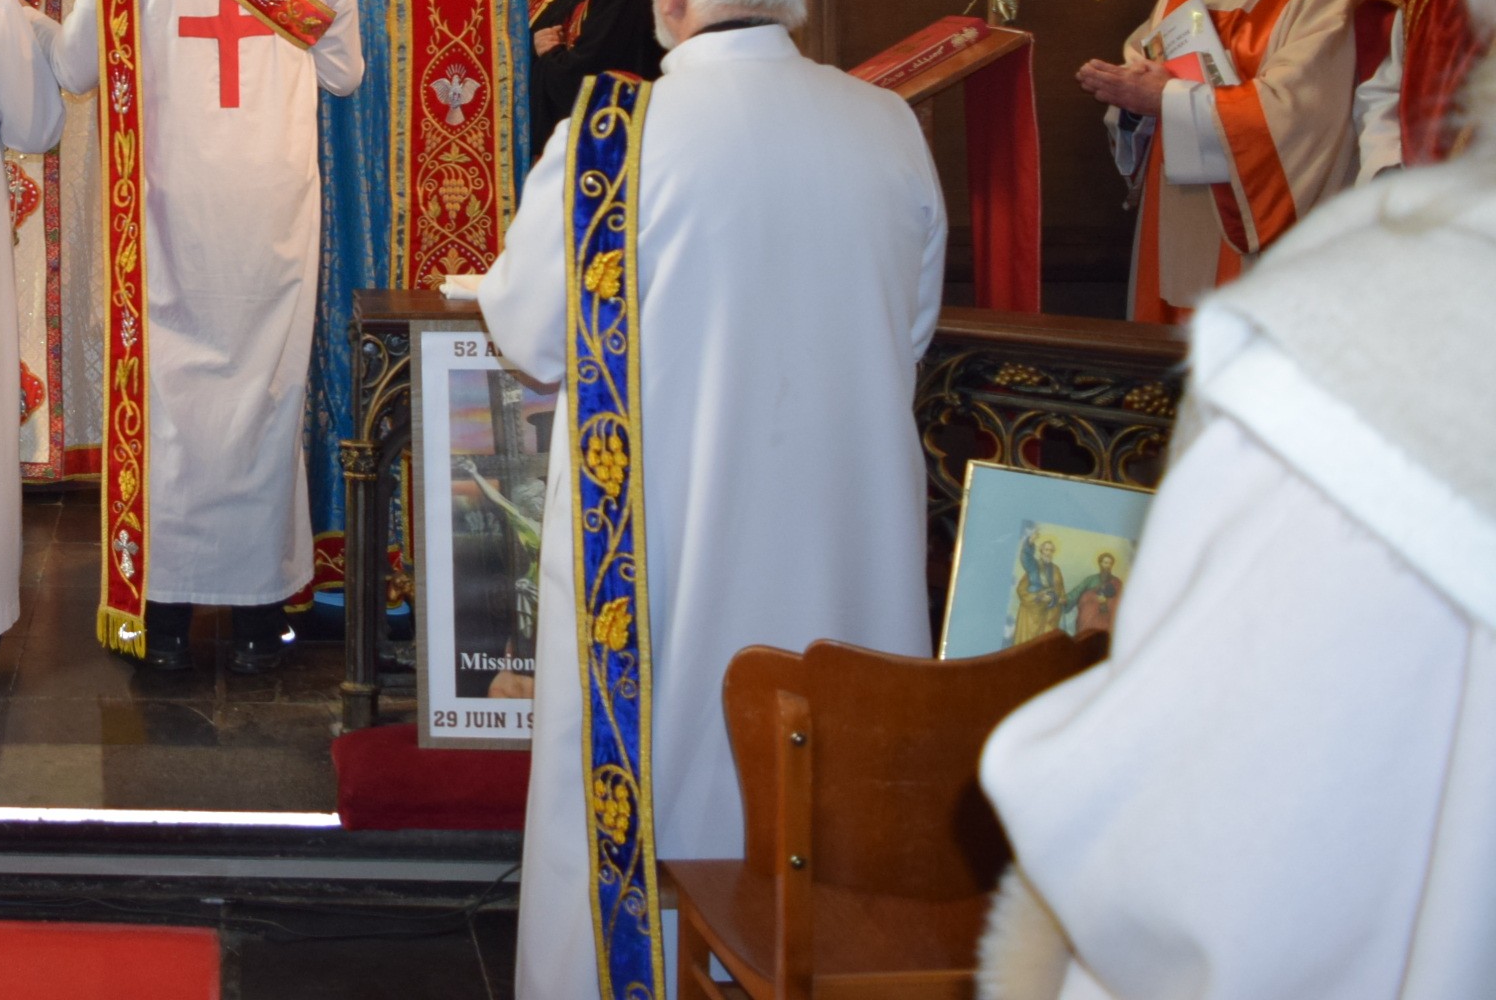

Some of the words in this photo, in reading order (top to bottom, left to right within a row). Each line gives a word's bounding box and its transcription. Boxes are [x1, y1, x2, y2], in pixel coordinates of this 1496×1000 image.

[454, 341, 478, 357] 52
[484, 341, 503, 357] A
[434, 710, 458, 728] 29
[465, 711, 507, 729] JUIN
